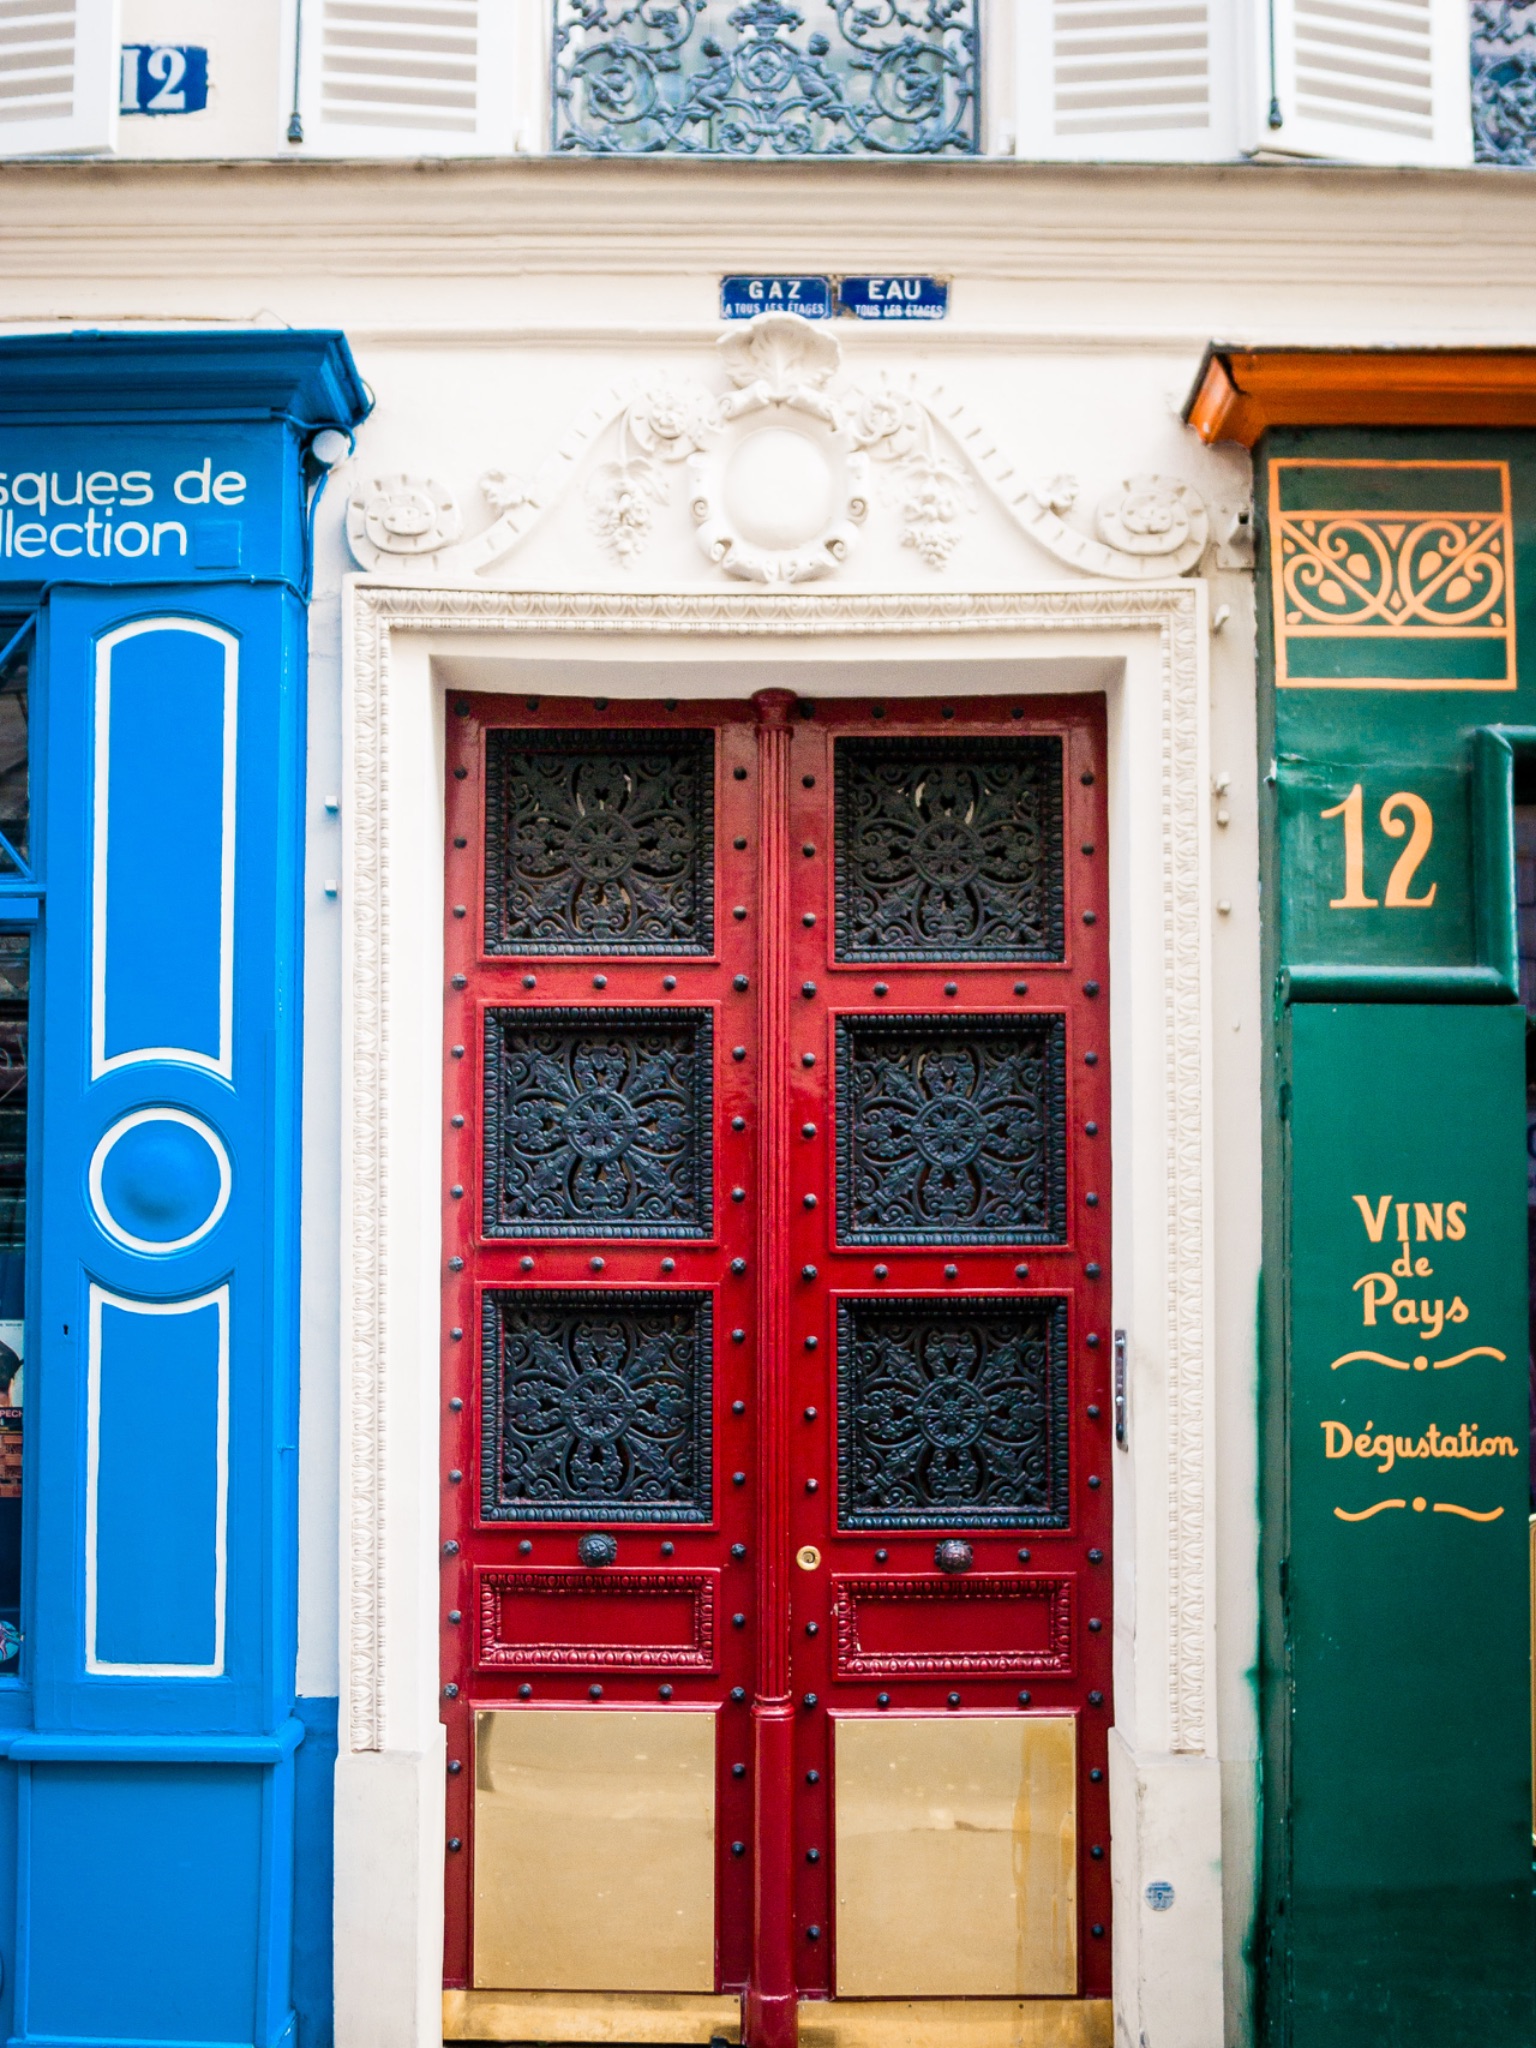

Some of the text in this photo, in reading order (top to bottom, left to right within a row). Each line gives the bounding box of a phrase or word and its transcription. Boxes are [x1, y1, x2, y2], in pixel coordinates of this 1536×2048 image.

[121, 47, 187, 109] 12
[735, 303, 760, 314] TOUS
[787, 300, 825, 315] ÉTAGES
[749, 280, 802, 300] GAZ
[855, 302, 944, 318] TOUS LES ÉTAGES
[868, 280, 922, 300] EAU
[0, 457, 247, 517] ques de
[1320, 783, 1438, 908] 12
[1352, 1194, 1468, 1243] VINS
[1391, 1240, 1434, 1277] de
[1352, 1271, 1470, 1340] Pays
[1320, 1419, 1519, 1474] Dégustation
